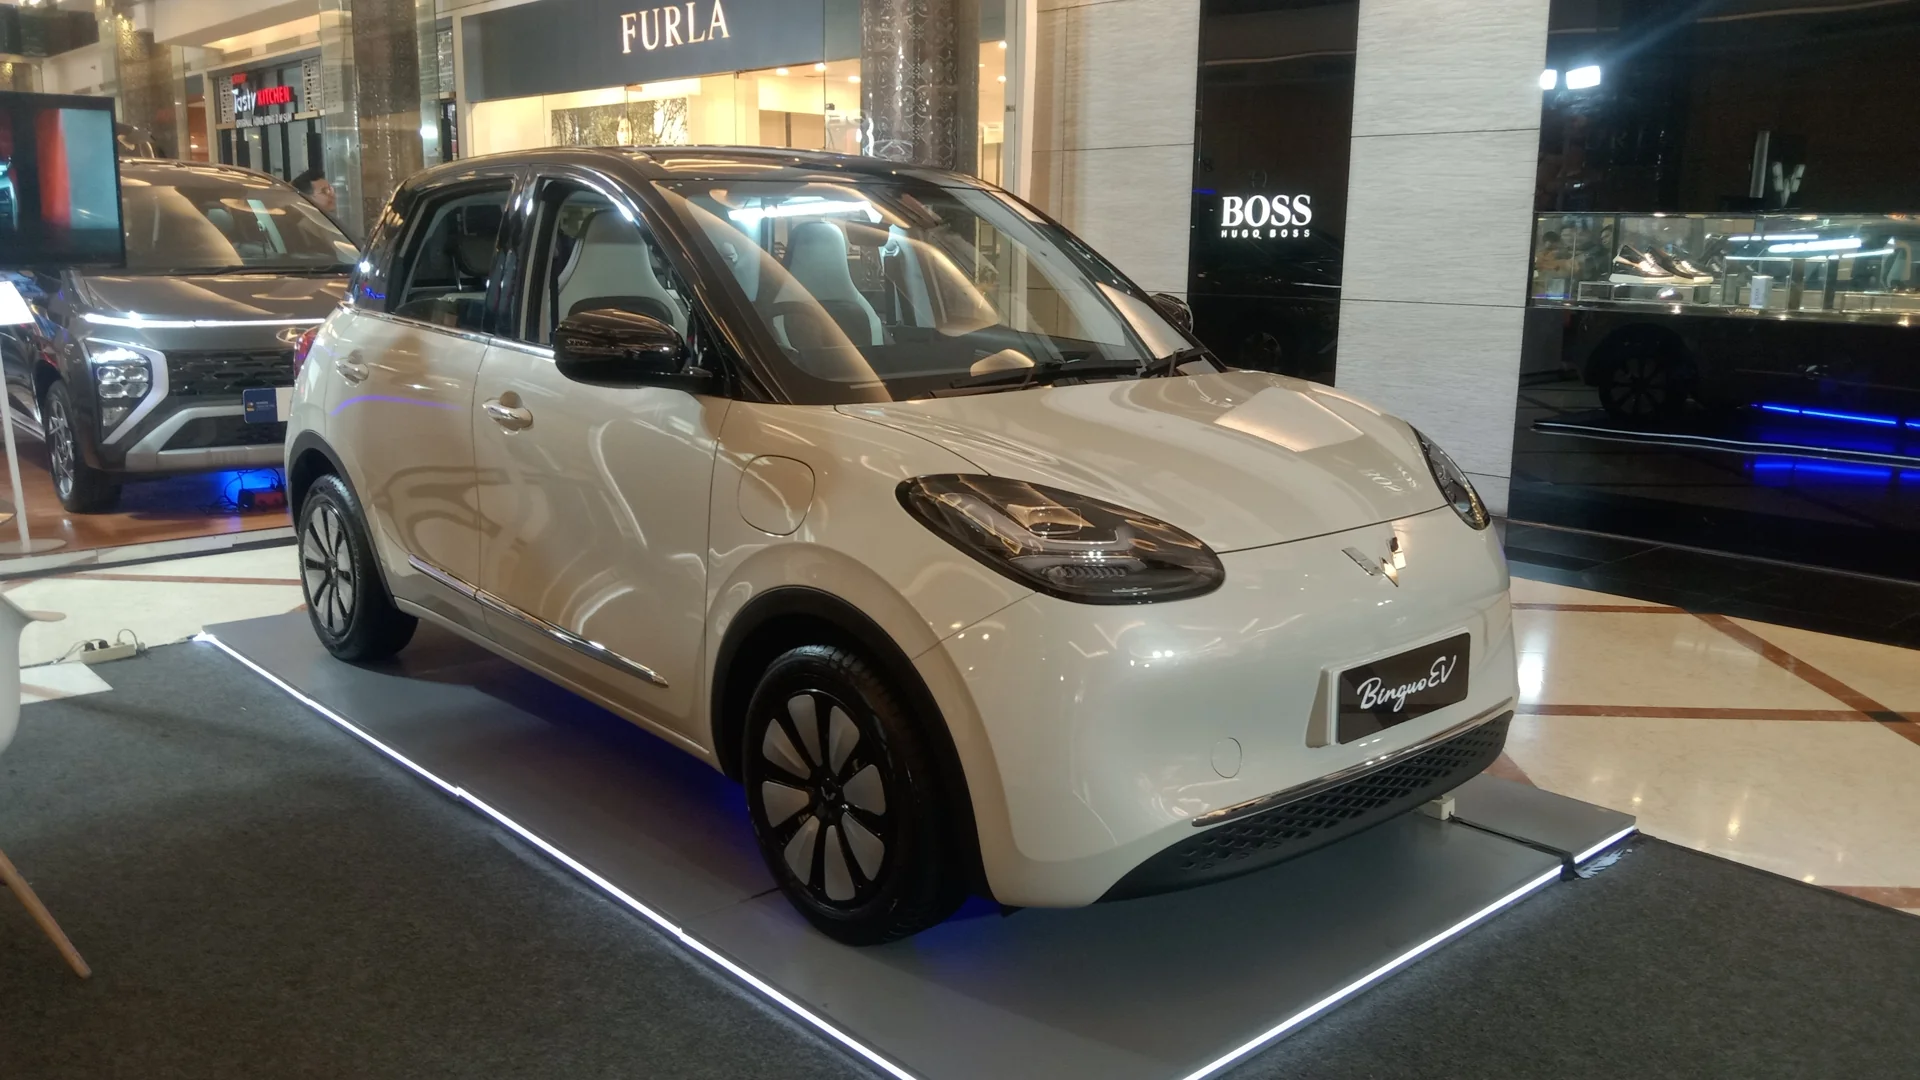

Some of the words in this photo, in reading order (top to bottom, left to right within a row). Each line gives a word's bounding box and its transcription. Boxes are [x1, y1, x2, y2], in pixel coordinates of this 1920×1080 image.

[620, 0, 730, 53] FURLA
[231, 88, 256, 114] Tasty
[258, 86, 290, 105] KITCHEN
[1221, 194, 1312, 227] BOSS
[1269, 229, 1310, 238] BOSS
